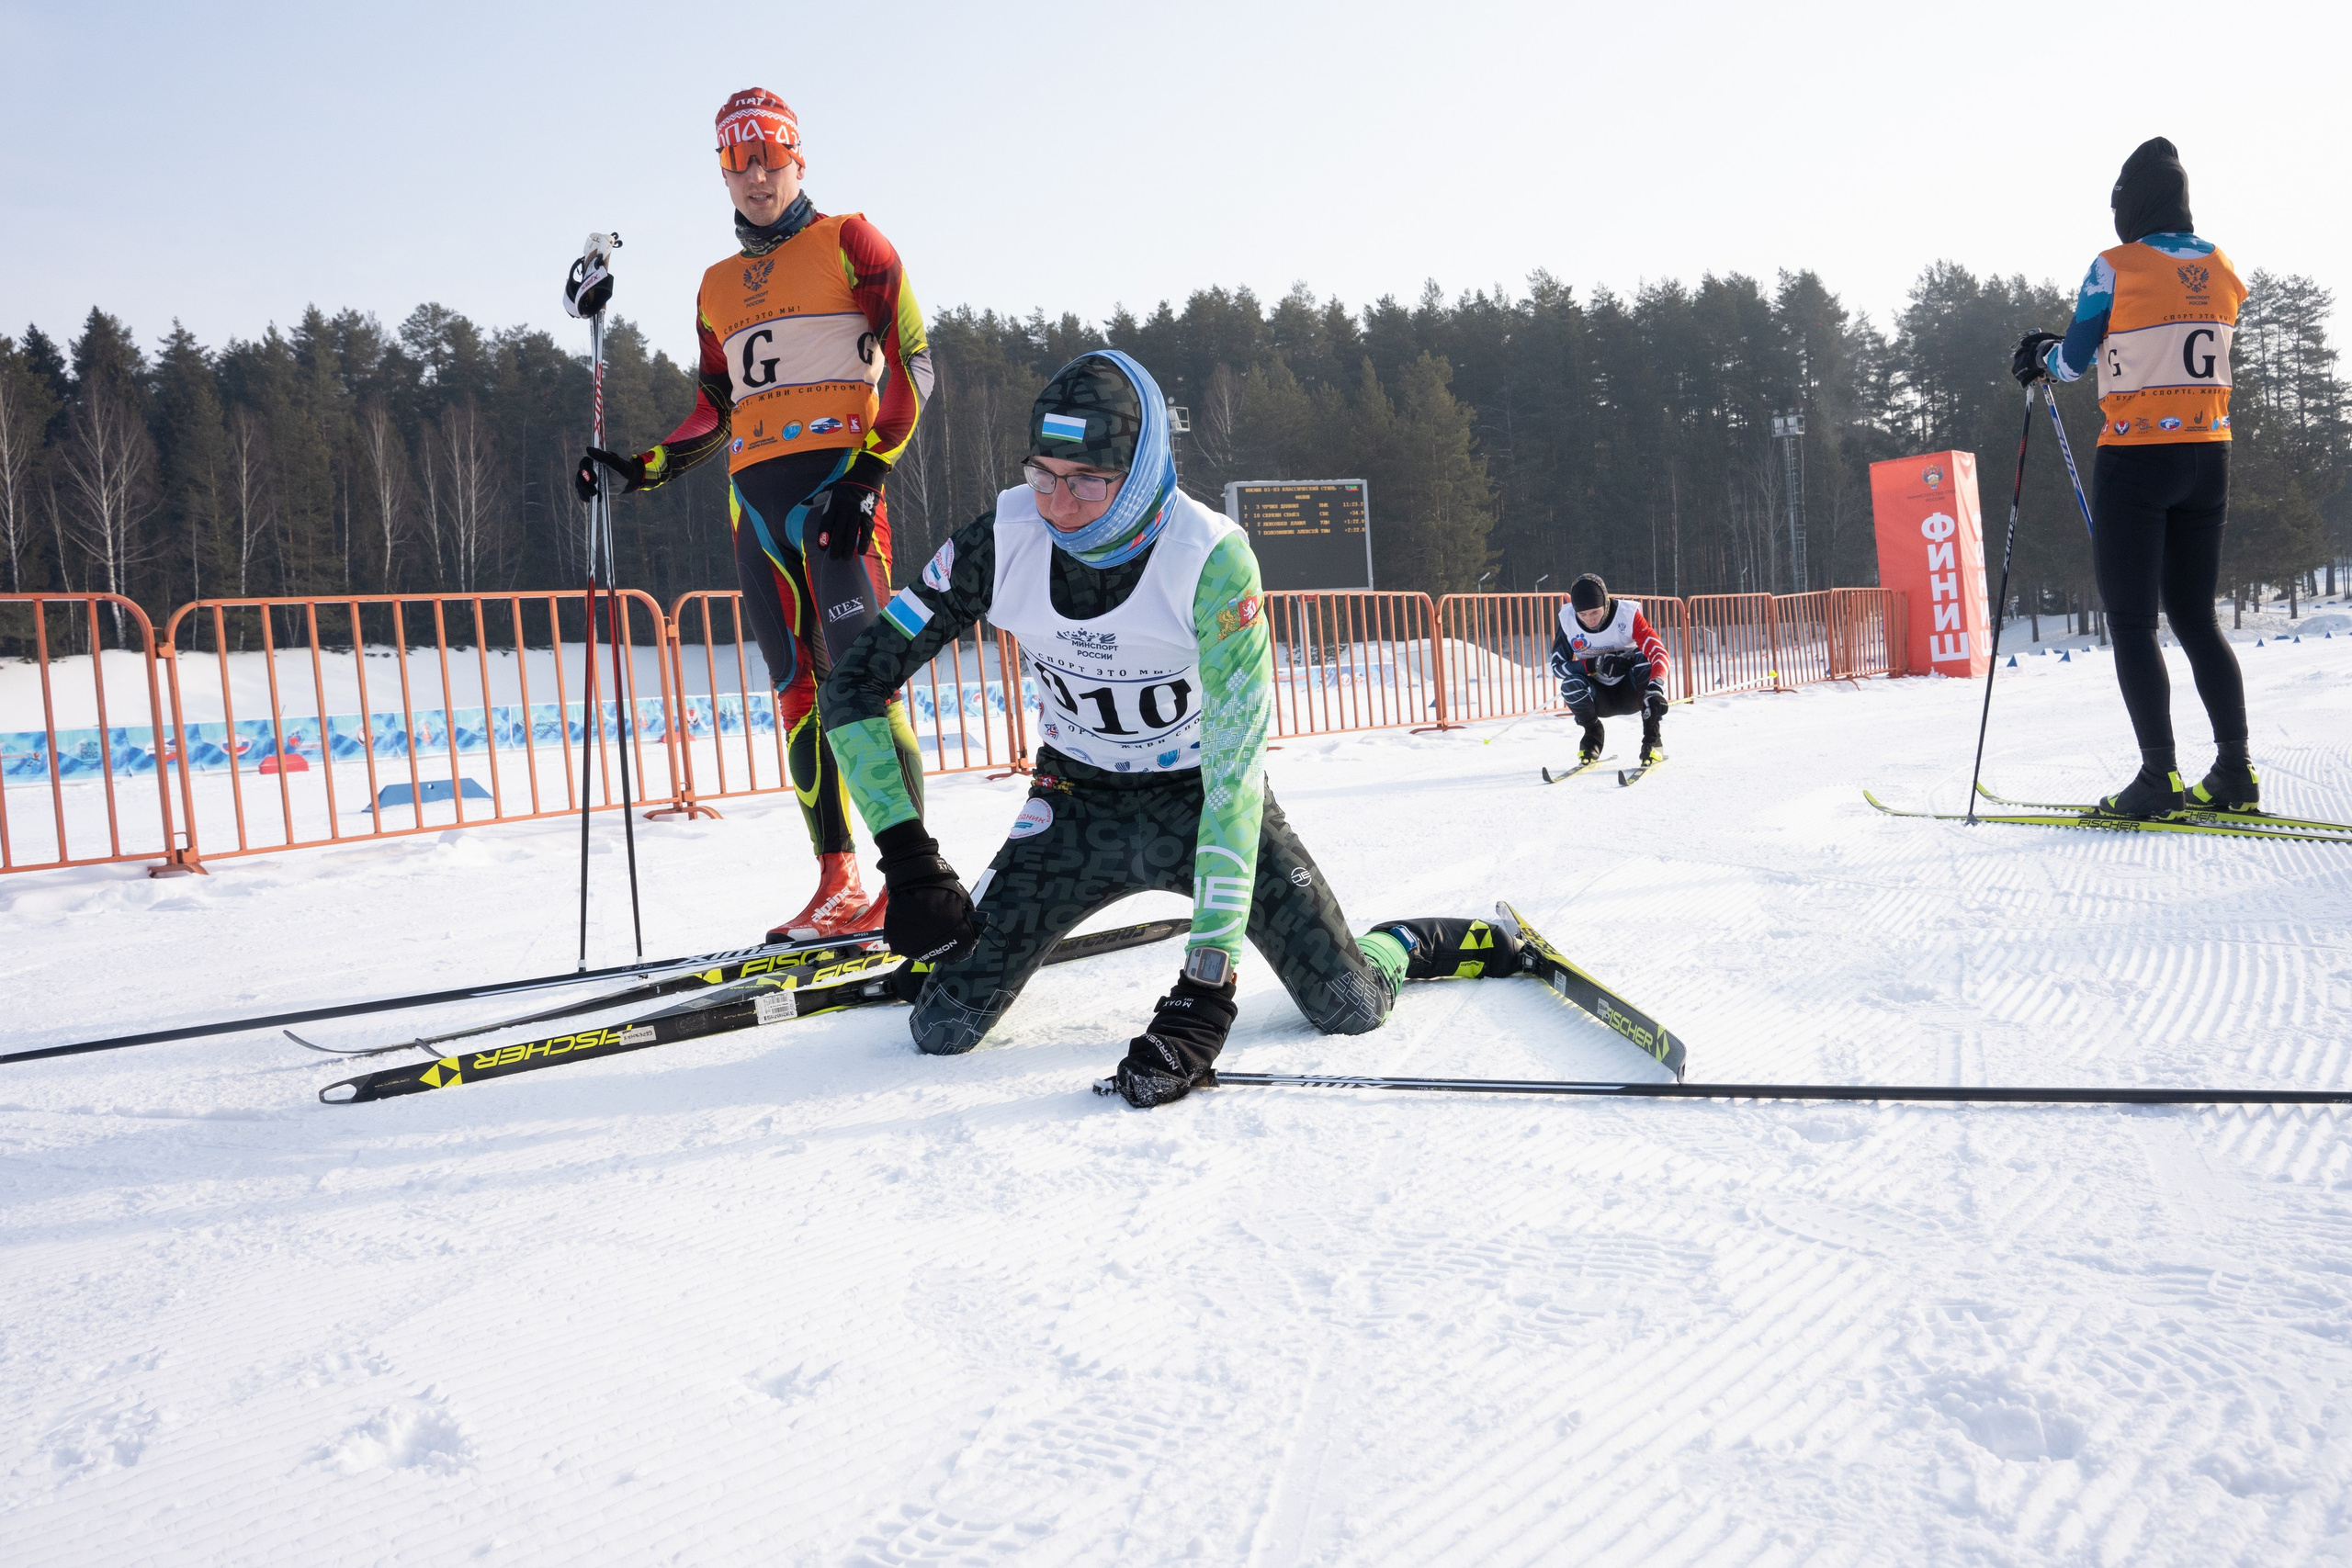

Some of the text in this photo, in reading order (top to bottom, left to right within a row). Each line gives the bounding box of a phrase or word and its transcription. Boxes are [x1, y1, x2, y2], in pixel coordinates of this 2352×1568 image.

[744, 291, 769, 304] МИНСПОРТ
[746, 298, 766, 308] РОССИИ
[724, 305, 801, 335] СПОРТ ЭТО МЫ!
[2163, 313, 2194, 321] СПОРТ
[742, 329, 780, 388] G
[857, 332, 874, 365] G
[2183, 329, 2216, 379] G
[2108, 349, 2122, 377] G
[758, 384, 862, 402] ЖИВИ СПОРТОМ!
[2153, 388, 2195, 396] СПОРТЕ,
[1921, 512, 1970, 663] ФИНИШ
[828, 597, 862, 622] ATEX
[1071, 640, 1119, 652] МИНСПОРТ
[1077, 650, 1113, 660] РОССИИ
[1038, 652, 1086, 672] СПОРТ
[2078, 818, 2140, 830] FISCHER
[2183, 810, 2217, 822] CHER
[811, 886, 852, 923] alpina
[676, 942, 797, 965] SWIX
[1601, 1007, 1654, 1052] FISCHER
[473, 1024, 633, 1069] FISCHER
